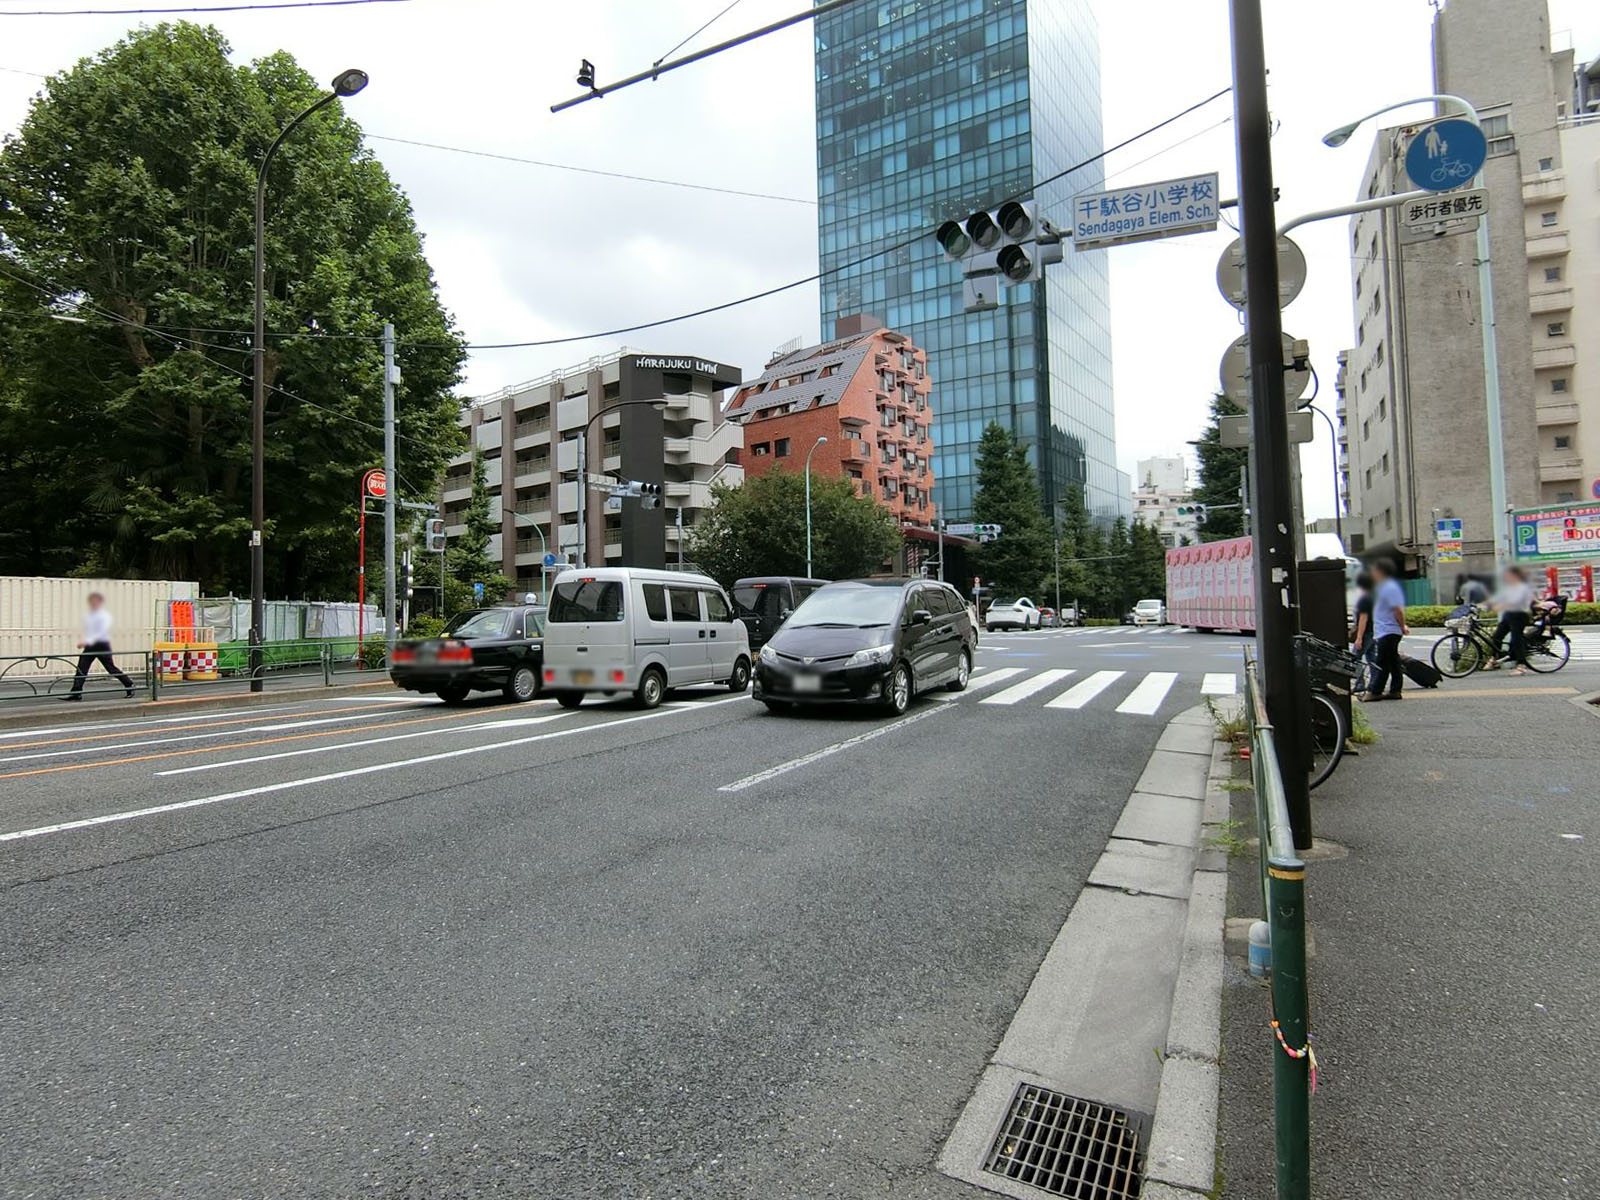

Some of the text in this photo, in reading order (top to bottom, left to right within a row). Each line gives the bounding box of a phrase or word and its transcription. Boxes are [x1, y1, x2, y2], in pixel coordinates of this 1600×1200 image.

[1079, 180, 1212, 219] 千駄谷小学校
[1409, 195, 1482, 221] 歩行者優先
[1078, 203, 1214, 236] Sendagaya Elem. Sch.
[636, 356, 692, 369] HARAJUKU
[1517, 525, 1535, 547] P
